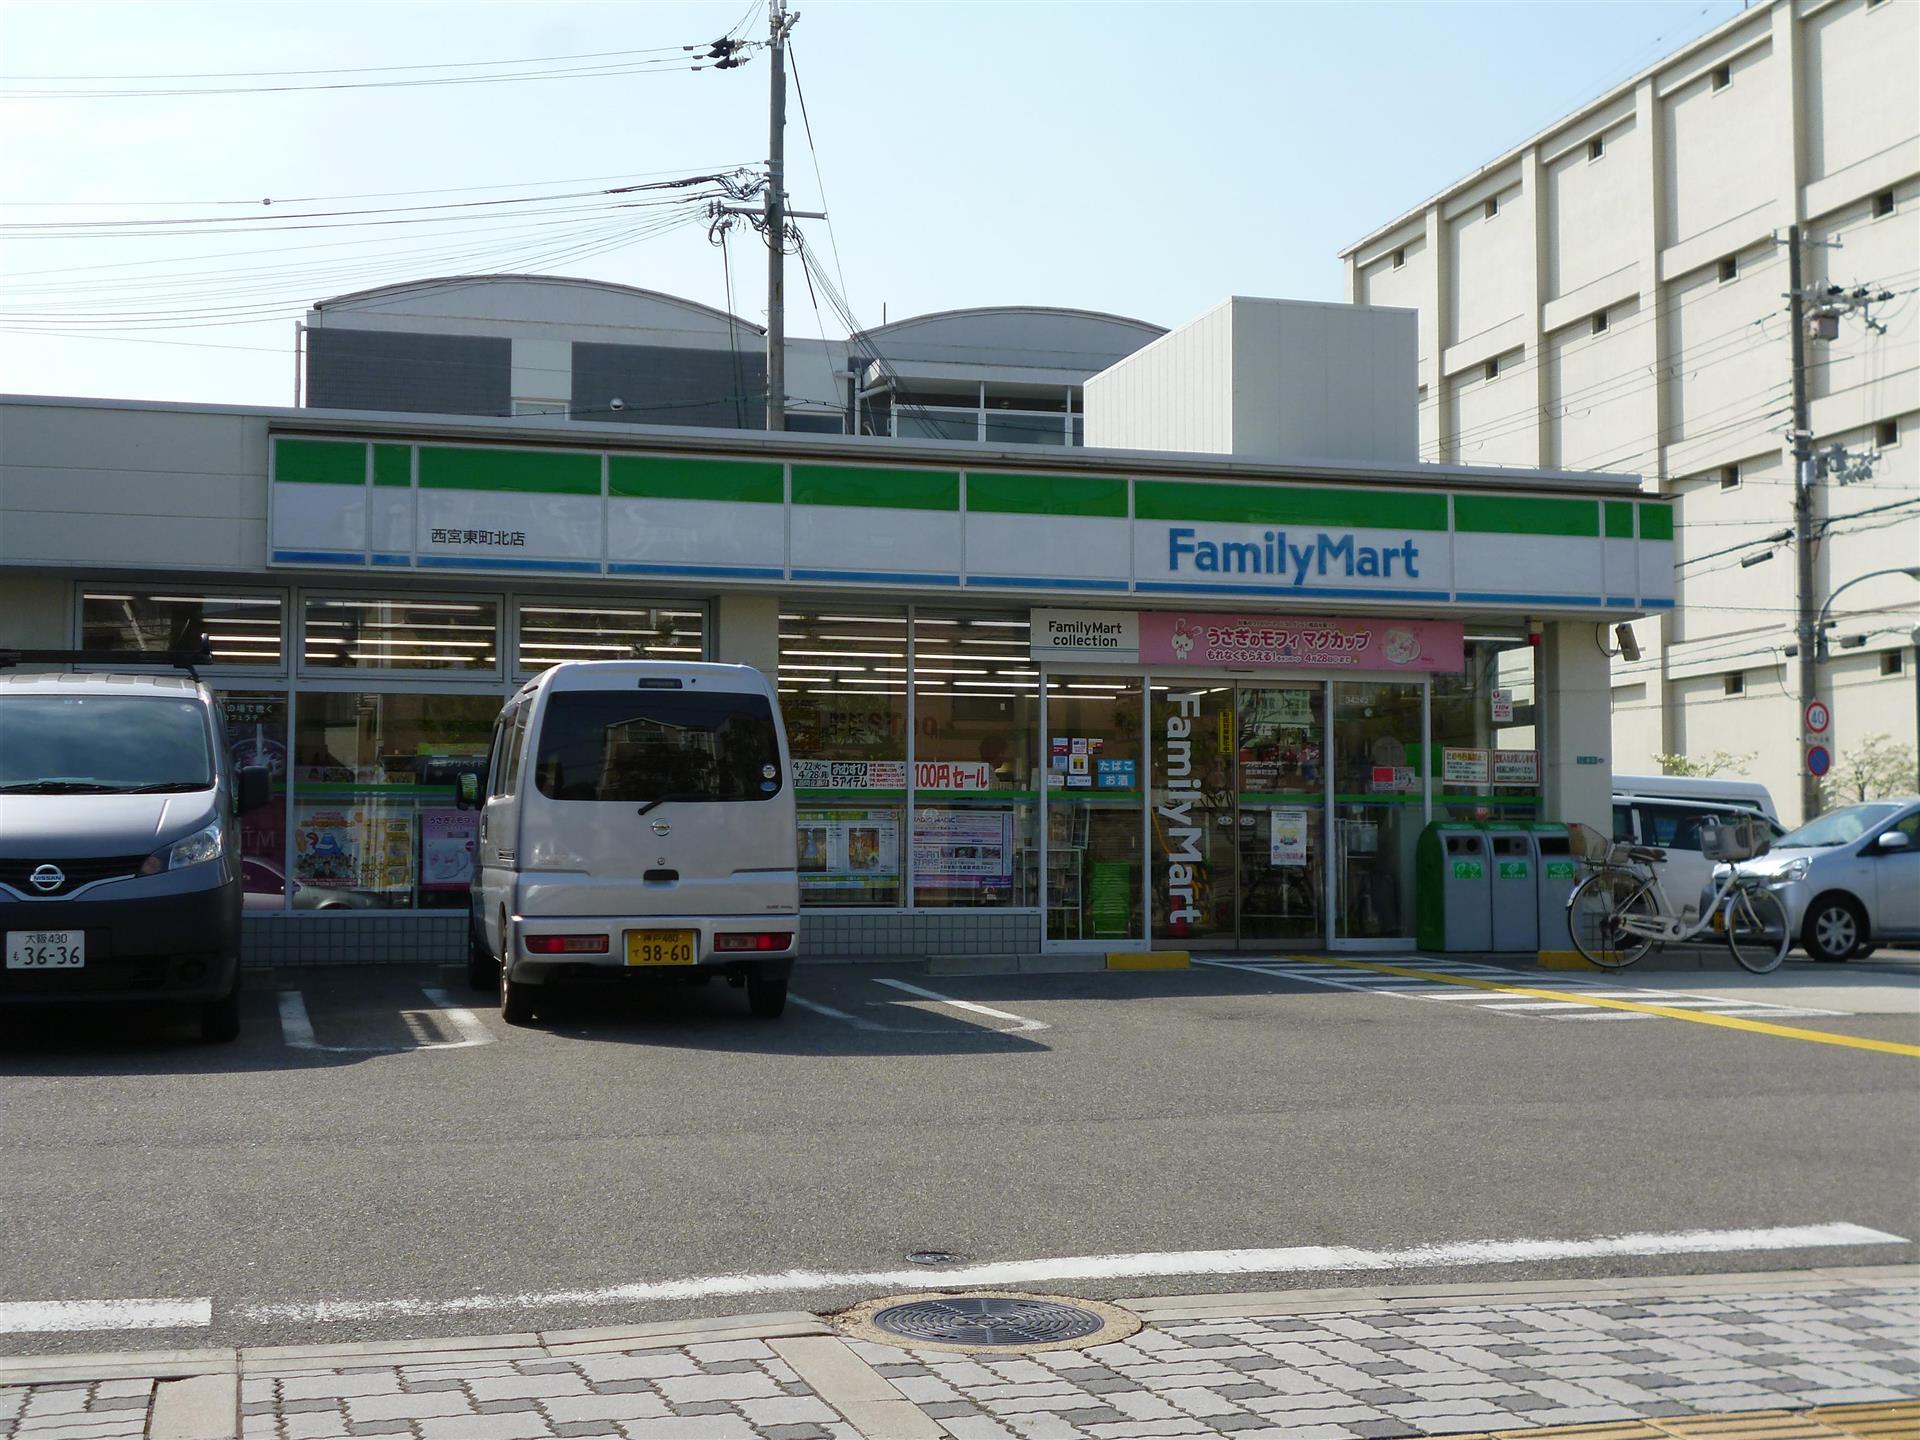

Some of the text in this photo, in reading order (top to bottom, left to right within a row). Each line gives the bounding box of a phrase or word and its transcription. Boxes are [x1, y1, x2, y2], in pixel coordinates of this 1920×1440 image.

[431, 528, 526, 547] 西宮東町北店
[1169, 527, 1420, 586] FamilyMart
[1048, 620, 1122, 636] FamilyMart
[1052, 634, 1118, 647] collection
[1207, 626, 1372, 649] うさぎのモフィ マグカップ
[1812, 709, 1825, 724] 40
[1100, 761, 1134, 771] たばこ
[832, 777, 867, 788] 5アイテム
[915, 764, 950, 788] 100円
[953, 765, 988, 788] セール
[1105, 775, 1129, 786] お酒
[1158, 694, 1202, 924] FamilyMart
[26, 933, 68, 944] 大阪430
[13, 946, 80, 965] も 36-36
[642, 944, 690, 961] 98-60
